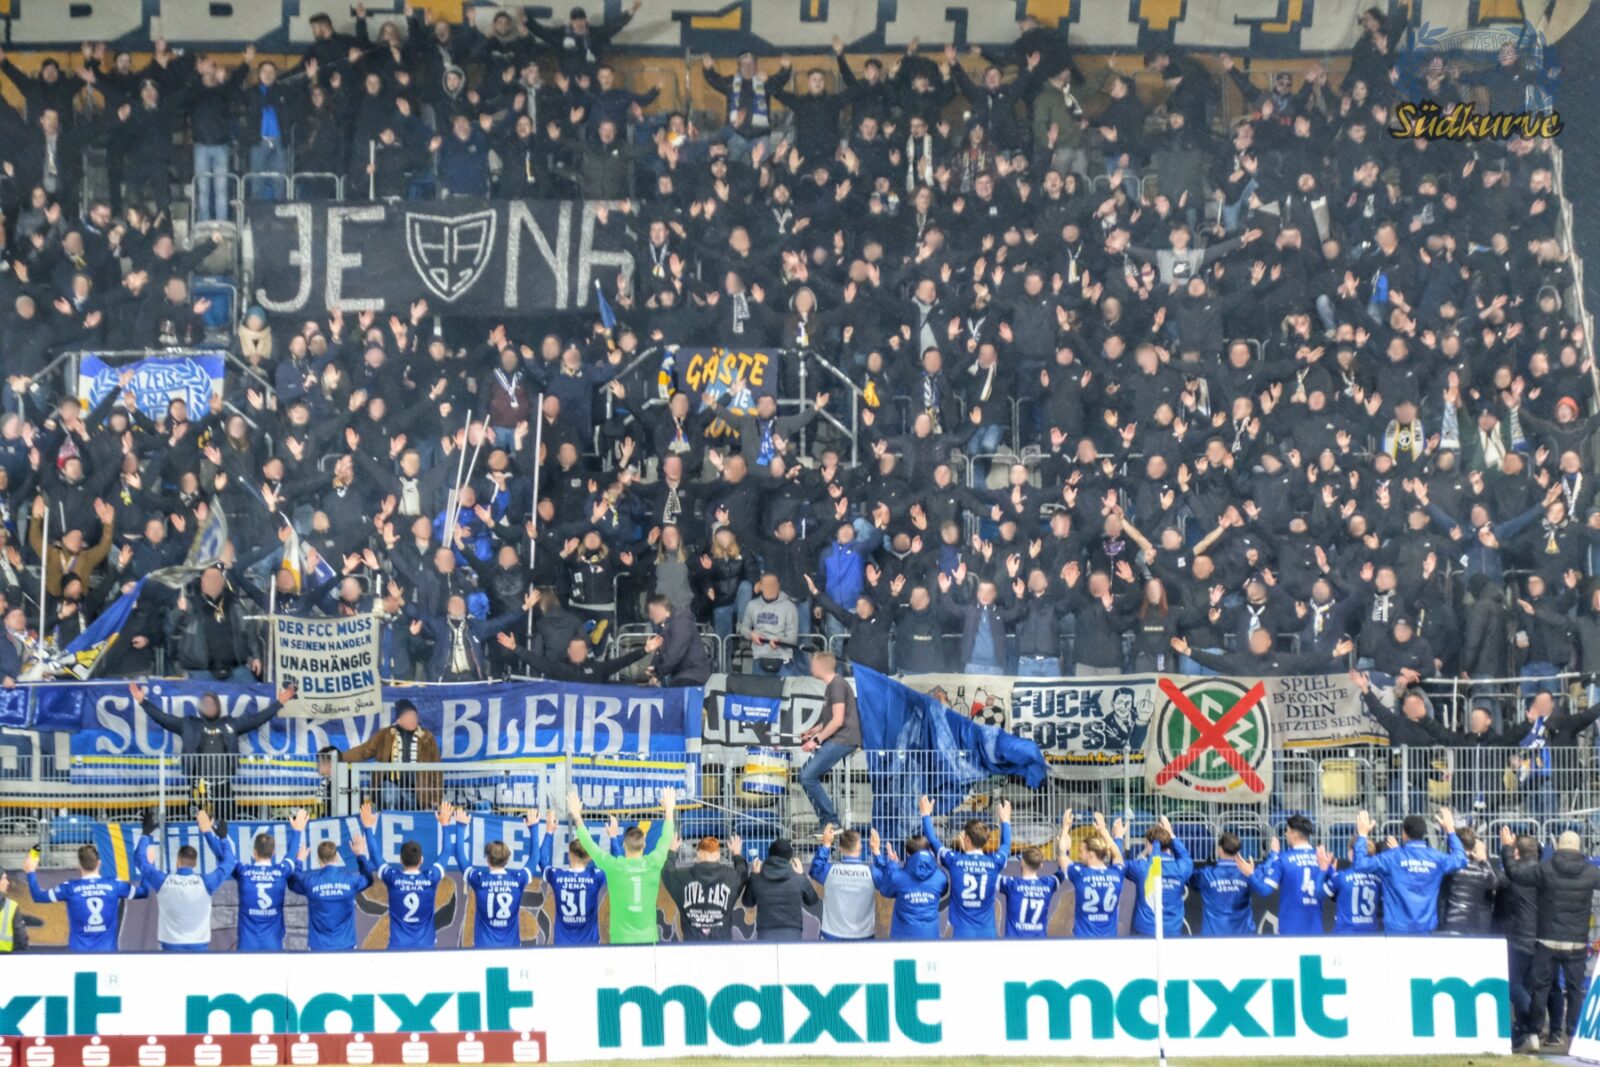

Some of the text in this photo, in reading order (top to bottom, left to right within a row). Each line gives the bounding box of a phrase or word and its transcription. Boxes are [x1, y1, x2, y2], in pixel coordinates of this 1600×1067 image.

[686, 346, 769, 391] GÄSTE
[278, 617, 372, 637] DER FCC MUSS
[280, 634, 372, 652] IN SEINEN HANDELN
[280, 650, 371, 673] UNABHÄNGIG
[302, 669, 375, 693] BLEIBEN
[1280, 675, 1336, 692] SPIEL
[1011, 689, 1104, 718] FUCK
[1286, 703, 1336, 719] DEIN
[441, 693, 664, 760] BLEIBT
[1331, 714, 1361, 727] SEIN
[1012, 720, 1106, 750] COPS
[832, 867, 869, 878] macron
[1301, 867, 1315, 896] 4
[256, 883, 272, 909] 5
[630, 876, 642, 904] 1
[684, 881, 731, 911] LIVE FAST
[961, 873, 988, 900] 21
[1082, 886, 1118, 912] 26
[86, 897, 104, 925] 8
[403, 892, 420, 919] 9
[487, 892, 513, 919] 18
[560, 889, 587, 916] 31
[1019, 897, 1045, 924] 17
[1351, 886, 1375, 916] 13
[186, 967, 534, 1033] maxit
[597, 959, 942, 1047] maxit
[1004, 954, 1349, 1040] maxit
